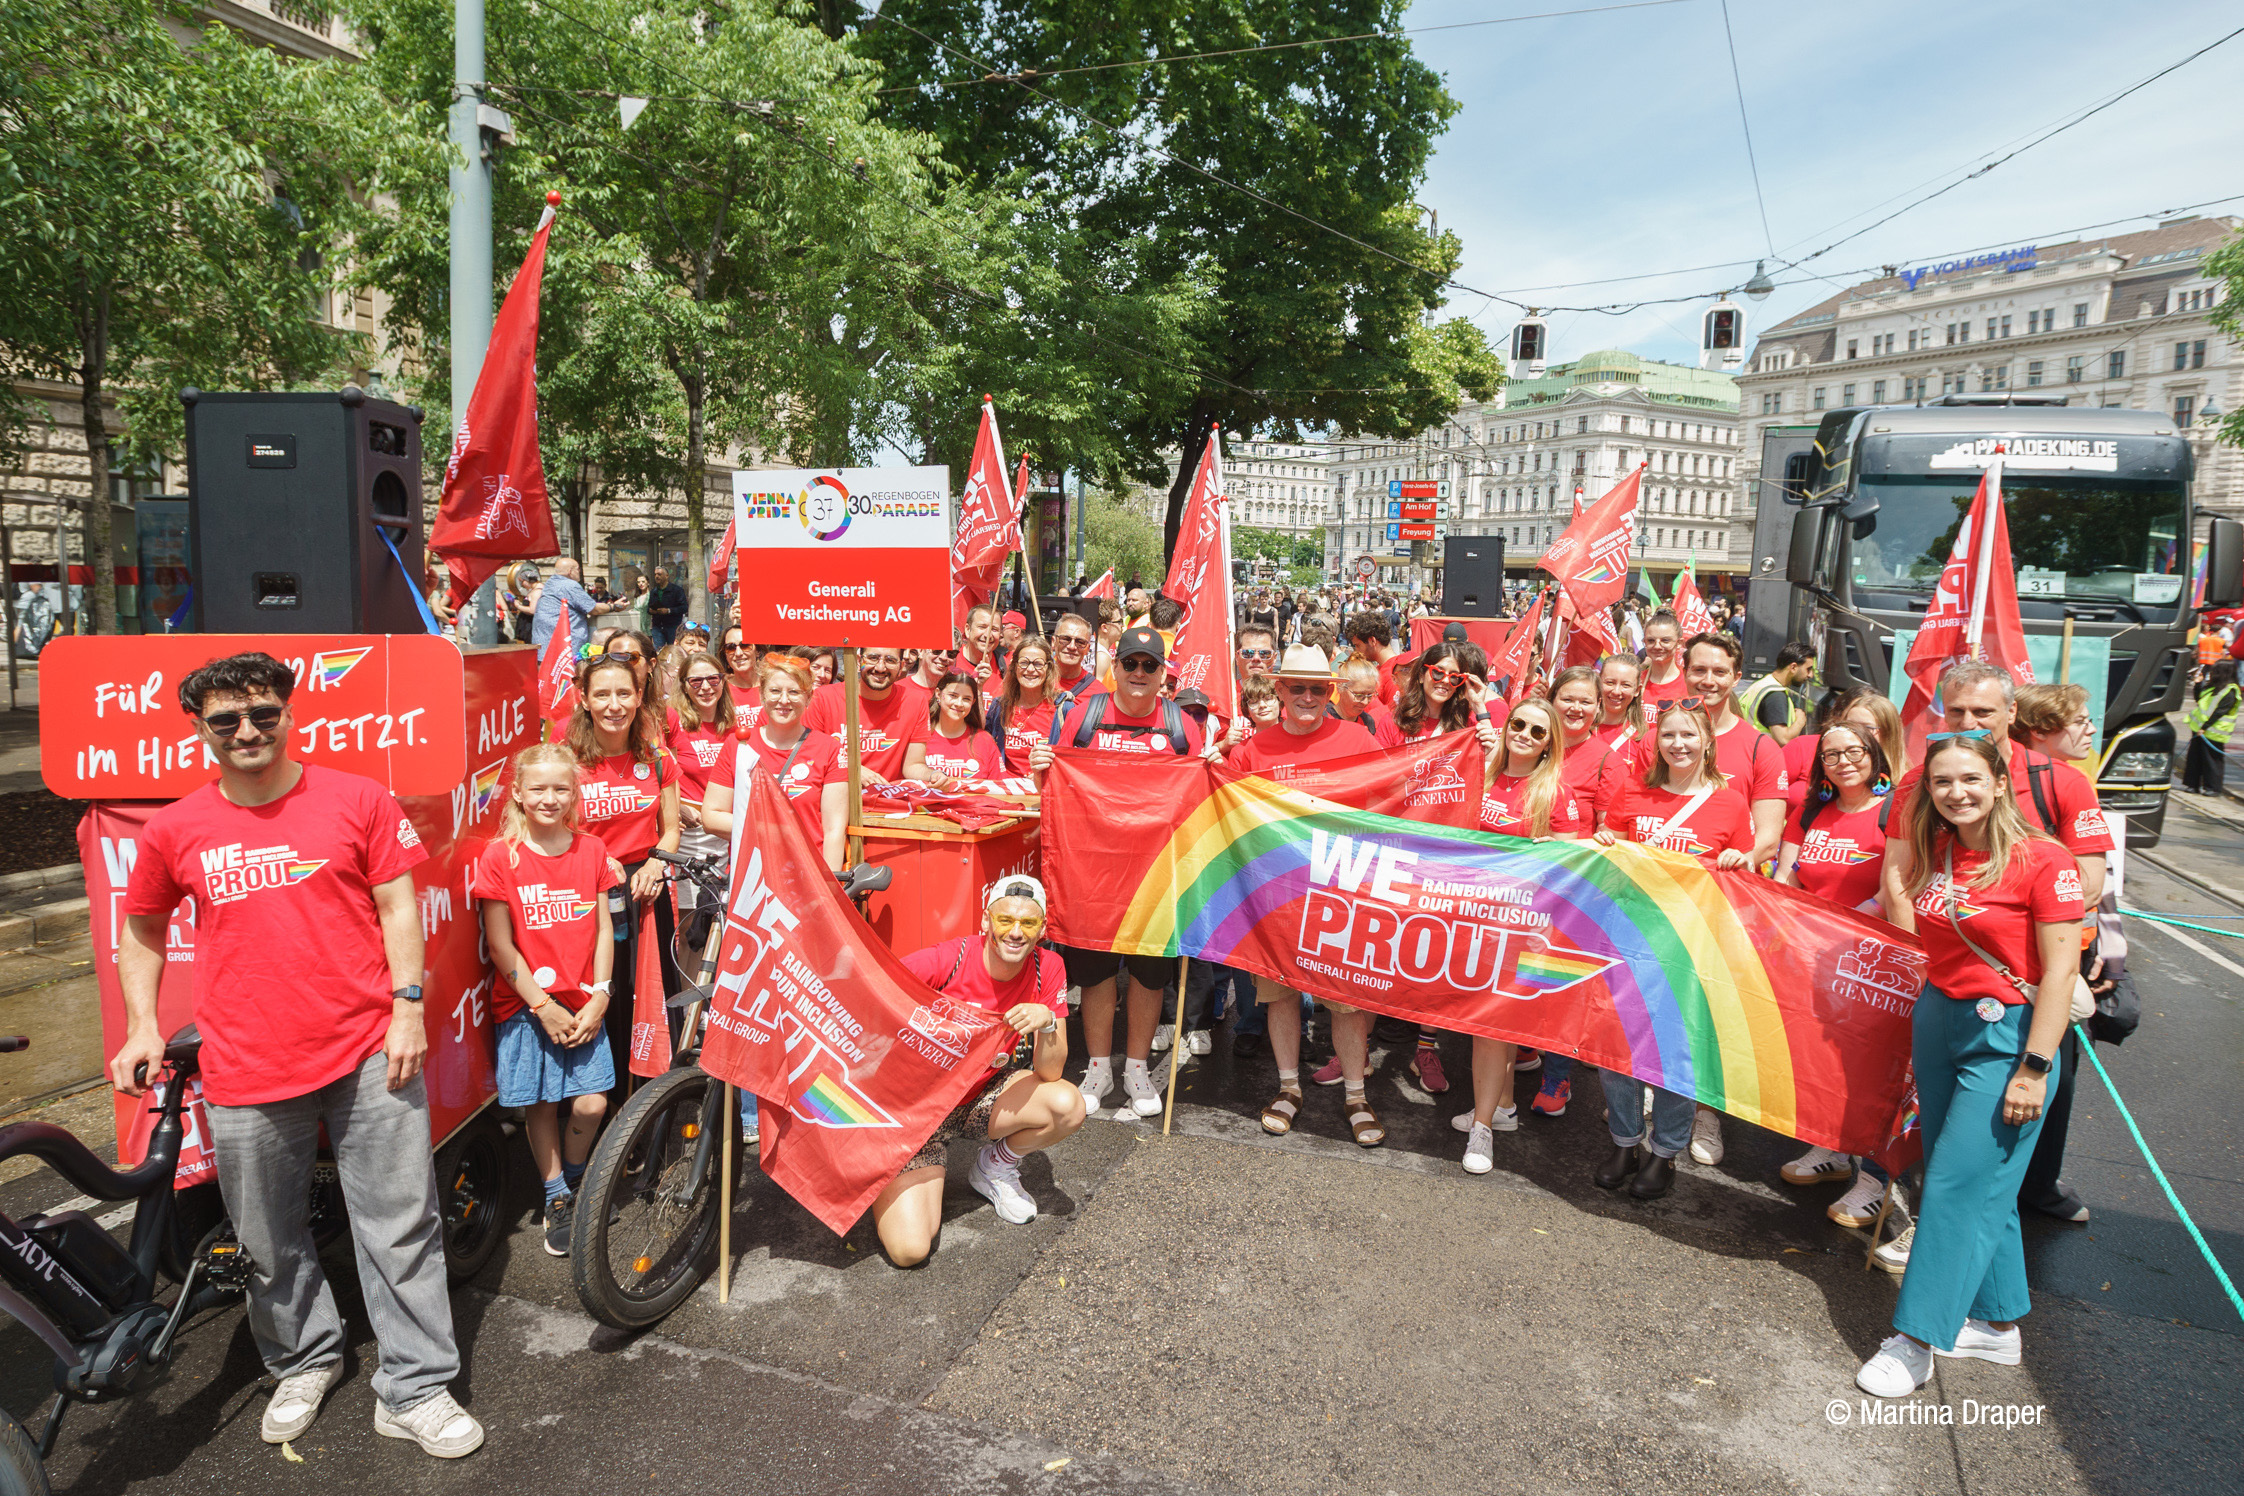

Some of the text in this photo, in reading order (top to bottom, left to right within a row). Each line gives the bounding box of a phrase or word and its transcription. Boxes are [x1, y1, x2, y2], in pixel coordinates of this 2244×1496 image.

[1932, 244, 2038, 275] VOLKSBANK
[1909, 300, 2015, 323] VICTORIA
[1976, 439, 2118, 457] PARADEKING.DE
[742, 493, 796, 505] VIENNA
[871, 491, 940, 501] REGENBOGEN
[748, 507, 791, 518] PRIDE
[813, 498, 833, 521] 37
[873, 503, 940, 517] PARADE
[1402, 528, 1432, 536] Freyung
[808, 581, 876, 598] Generali
[2031, 580, 2051, 592] 31
[776, 604, 911, 626] Versicherung AG
[299, 707, 428, 754] JETZT.
[478, 696, 526, 755] ALLE
[690, 740, 711, 752] WE
[1098, 733, 1122, 748] WE
[925, 754, 945, 767] WE
[581, 781, 610, 800] WE
[1404, 789, 1466, 807] GENERALI
[584, 795, 657, 819] PROUD
[1636, 816, 1665, 833] WE
[1804, 829, 1830, 846] WE
[200, 843, 244, 873] WE
[1800, 843, 1880, 866] PROUD
[1309, 828, 1419, 906] WE
[1422, 878, 1534, 907] RAINBOWING
[205, 858, 330, 900] PROUD
[517, 883, 549, 904] WE
[523, 900, 597, 925] PROUD
[1418, 896, 1552, 928] OUR INCLUSION
[1298, 888, 1626, 1000] PROUD
[167, 951, 195, 962] GROU
[1296, 956, 1394, 992] GENERALI GROUP
[781, 951, 864, 1038] RAINBOWING
[735, 1020, 771, 1046] GROUP
[796, 996, 866, 1064] INCLUSION
[897, 1027, 960, 1071] GENERALI
